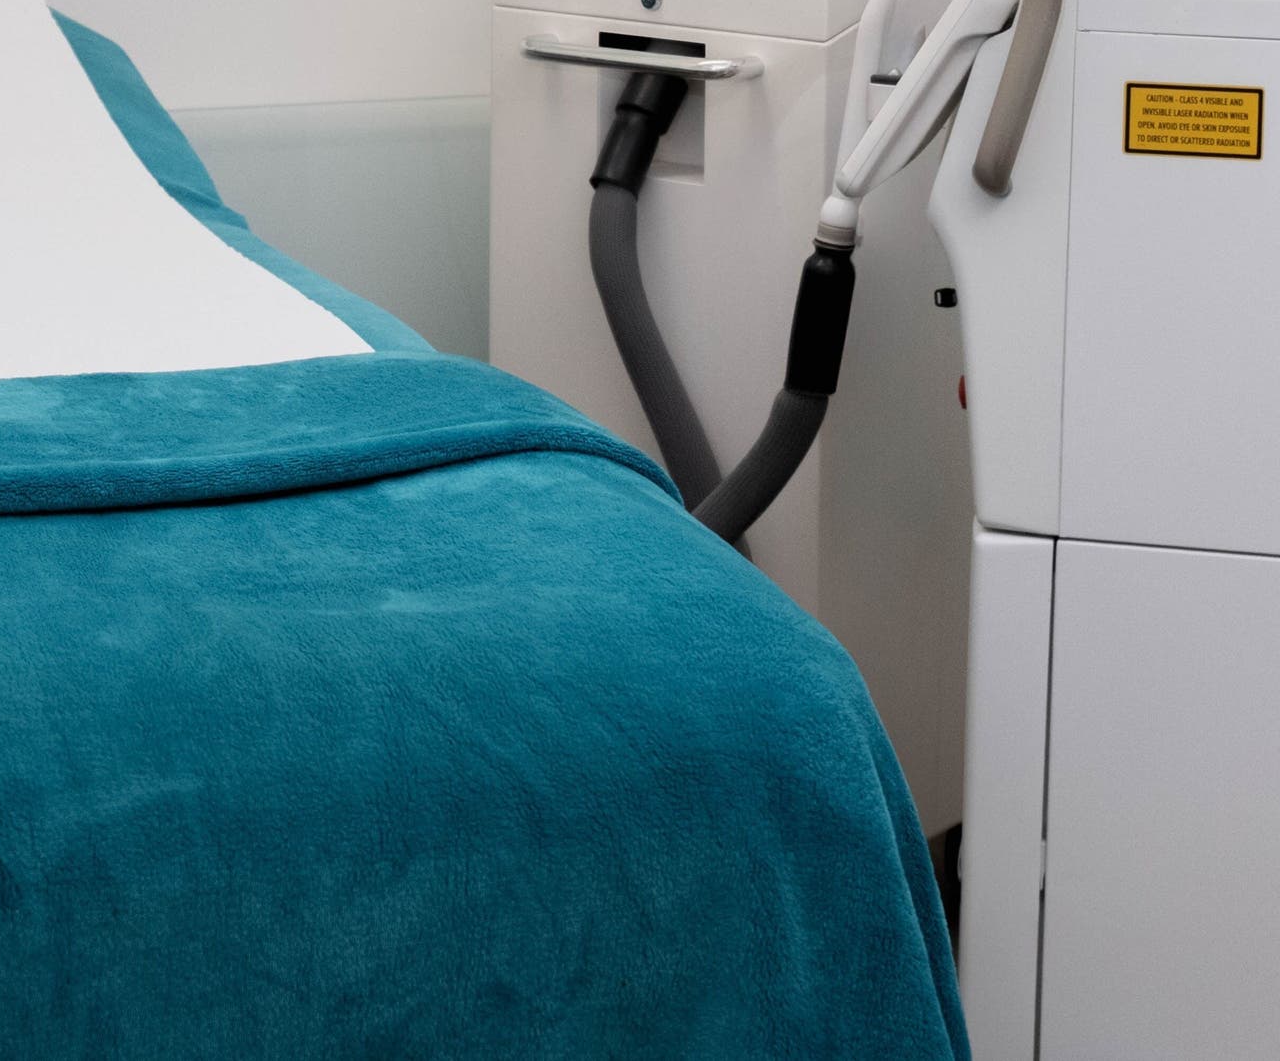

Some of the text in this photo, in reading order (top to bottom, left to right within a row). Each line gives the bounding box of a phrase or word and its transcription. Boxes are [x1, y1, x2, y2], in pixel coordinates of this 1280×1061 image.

[1146, 94, 1174, 103] CAUTION
[1179, 95, 1199, 104] CLASS
[1204, 97, 1228, 106] VISIBLE
[1230, 98, 1244, 107] AND
[1142, 107, 1249, 120] INVISIBLE LASER RADIATION WHEN
[1158, 121, 1178, 130] AVOID
[1178, 123, 1190, 131] EYE
[1191, 123, 1201, 131] OR
[1202, 124, 1217, 132] SKIN
[1218, 125, 1250, 134] EXPOSURE
[1137, 134, 1251, 147] TO DIRECT OR SCATTERED RADIATION
